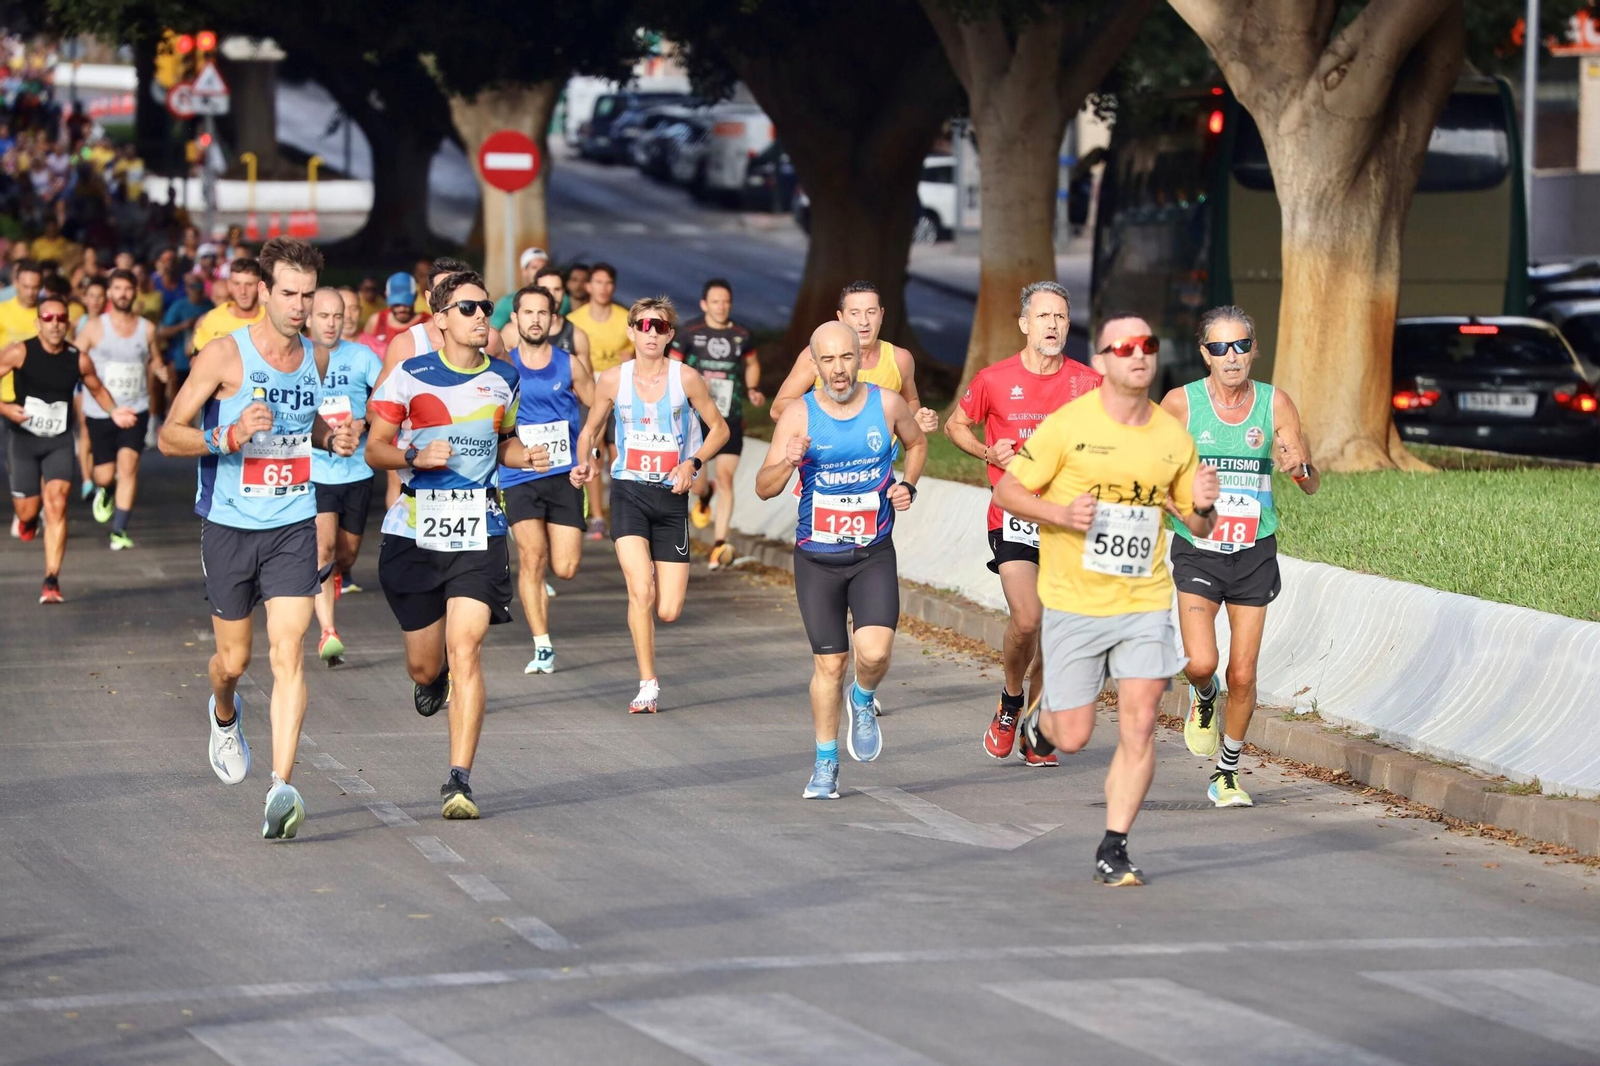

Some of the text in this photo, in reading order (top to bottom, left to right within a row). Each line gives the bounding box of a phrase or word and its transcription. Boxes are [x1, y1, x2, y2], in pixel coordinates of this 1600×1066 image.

[29, 415, 62, 431] 1897
[448, 435, 493, 449] Málaga
[460, 447, 492, 457] 2024
[640, 455, 662, 472] 81
[1201, 458, 1260, 472] ATLETISMO
[263, 463, 293, 487] 65
[1216, 474, 1263, 489] EMOLINO
[423, 516, 481, 538] 2547
[826, 514, 866, 536] 129
[1094, 532, 1151, 559] 5869
